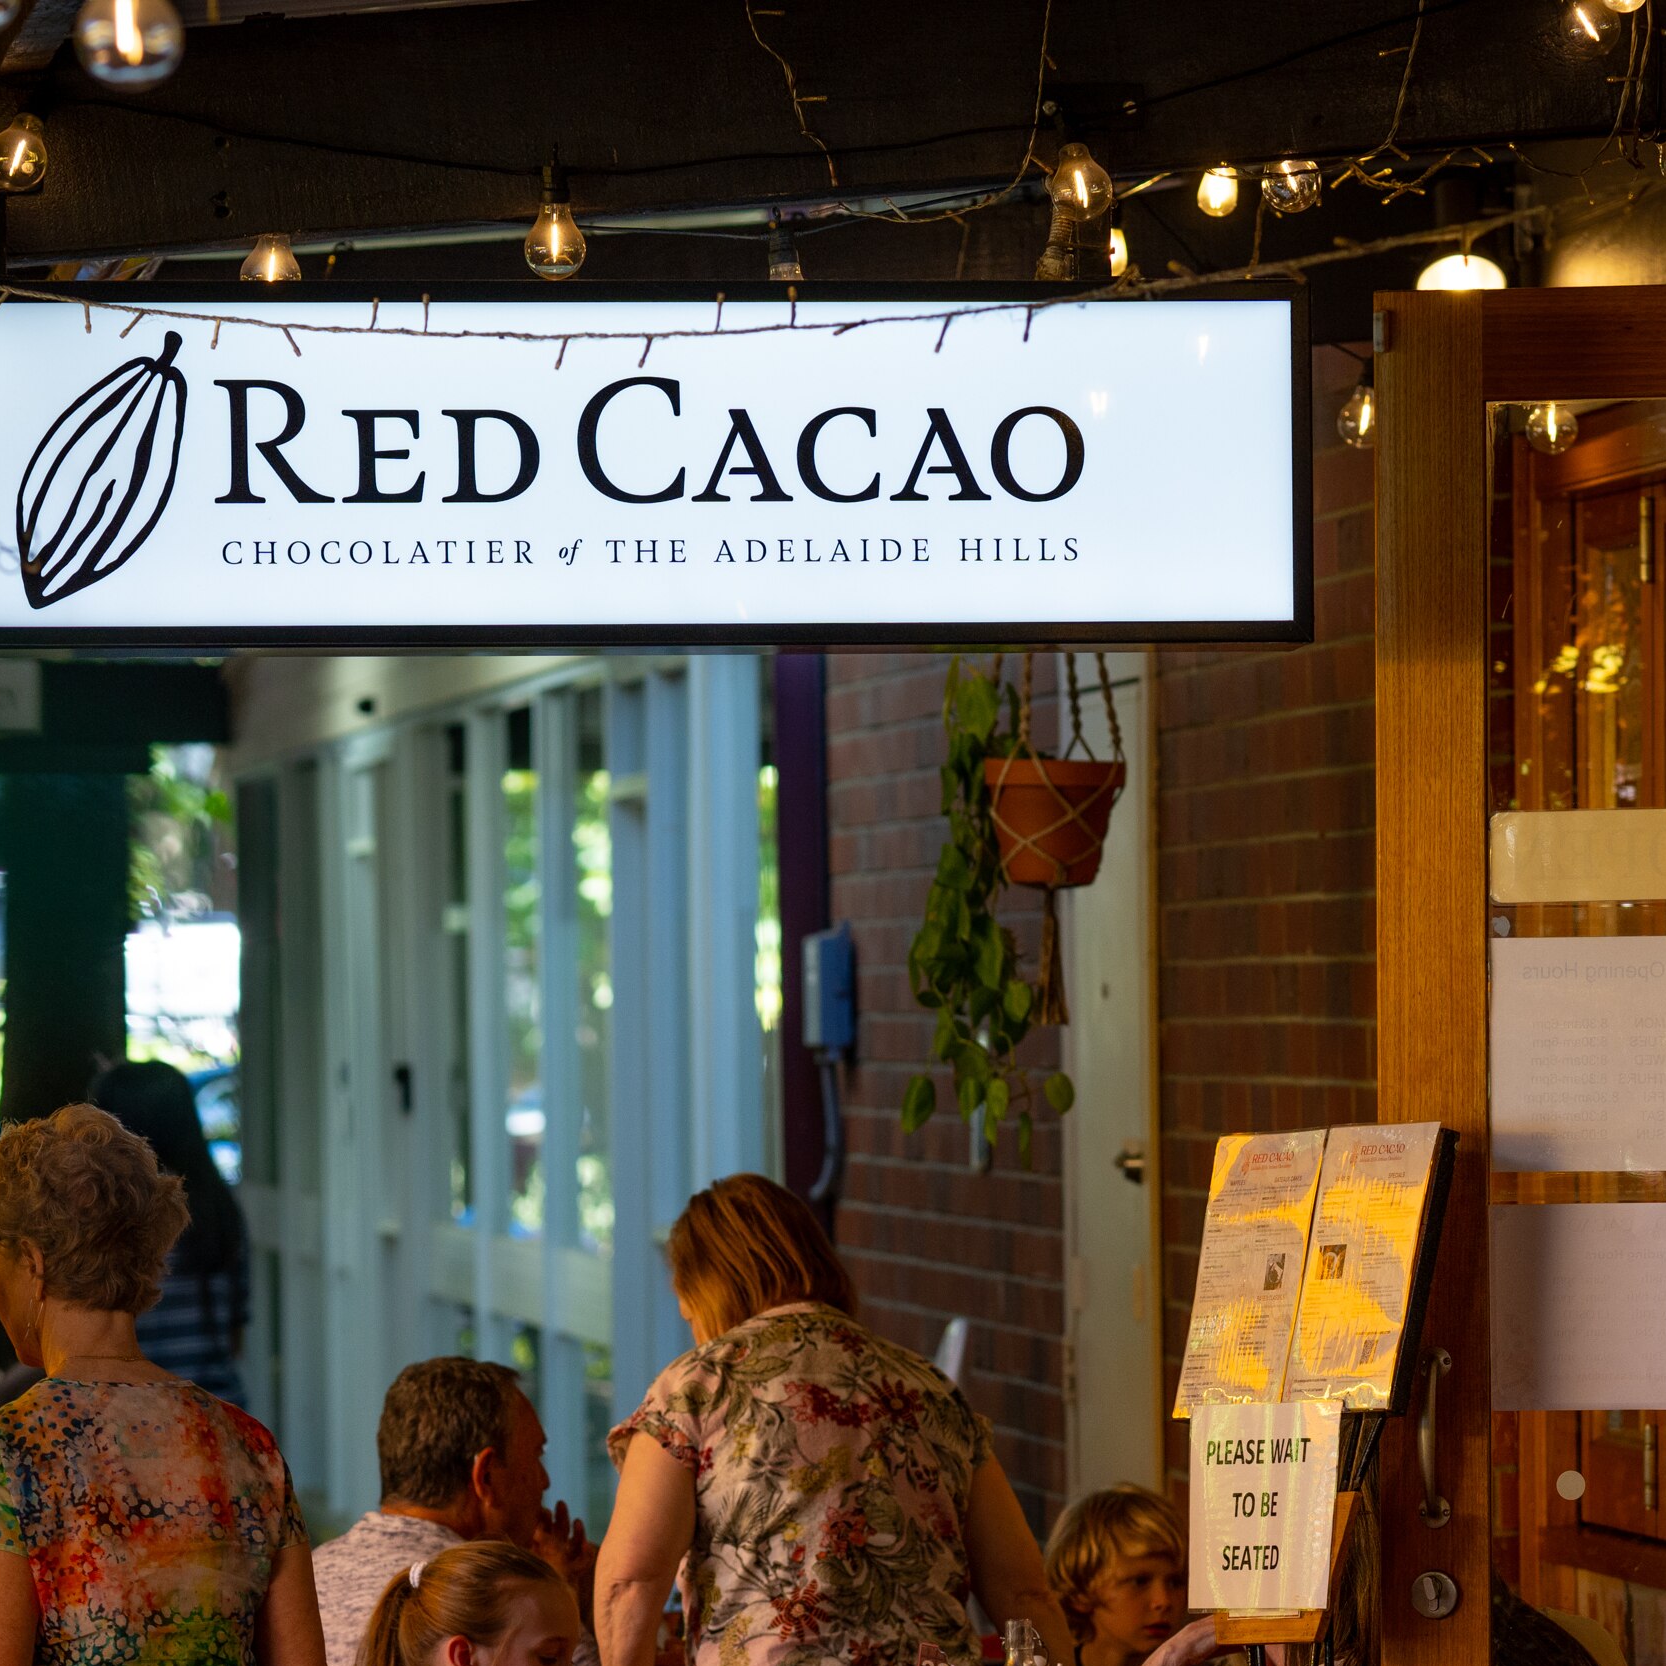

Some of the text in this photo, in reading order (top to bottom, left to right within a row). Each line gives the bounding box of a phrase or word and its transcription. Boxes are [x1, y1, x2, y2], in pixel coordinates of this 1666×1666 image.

[214, 376, 1085, 504] RED CACAO
[222, 537, 1082, 568] CHOCOLATIER of THE ADELAIDE HILLS
[1252, 1150, 1295, 1164] RED CACAO
[1360, 1143, 1406, 1156] RED CACAO
[1206, 1437, 1311, 1465] PLEASE WAIT
[1232, 1492, 1279, 1518] TO BE
[1222, 1544, 1280, 1571] SEATED
